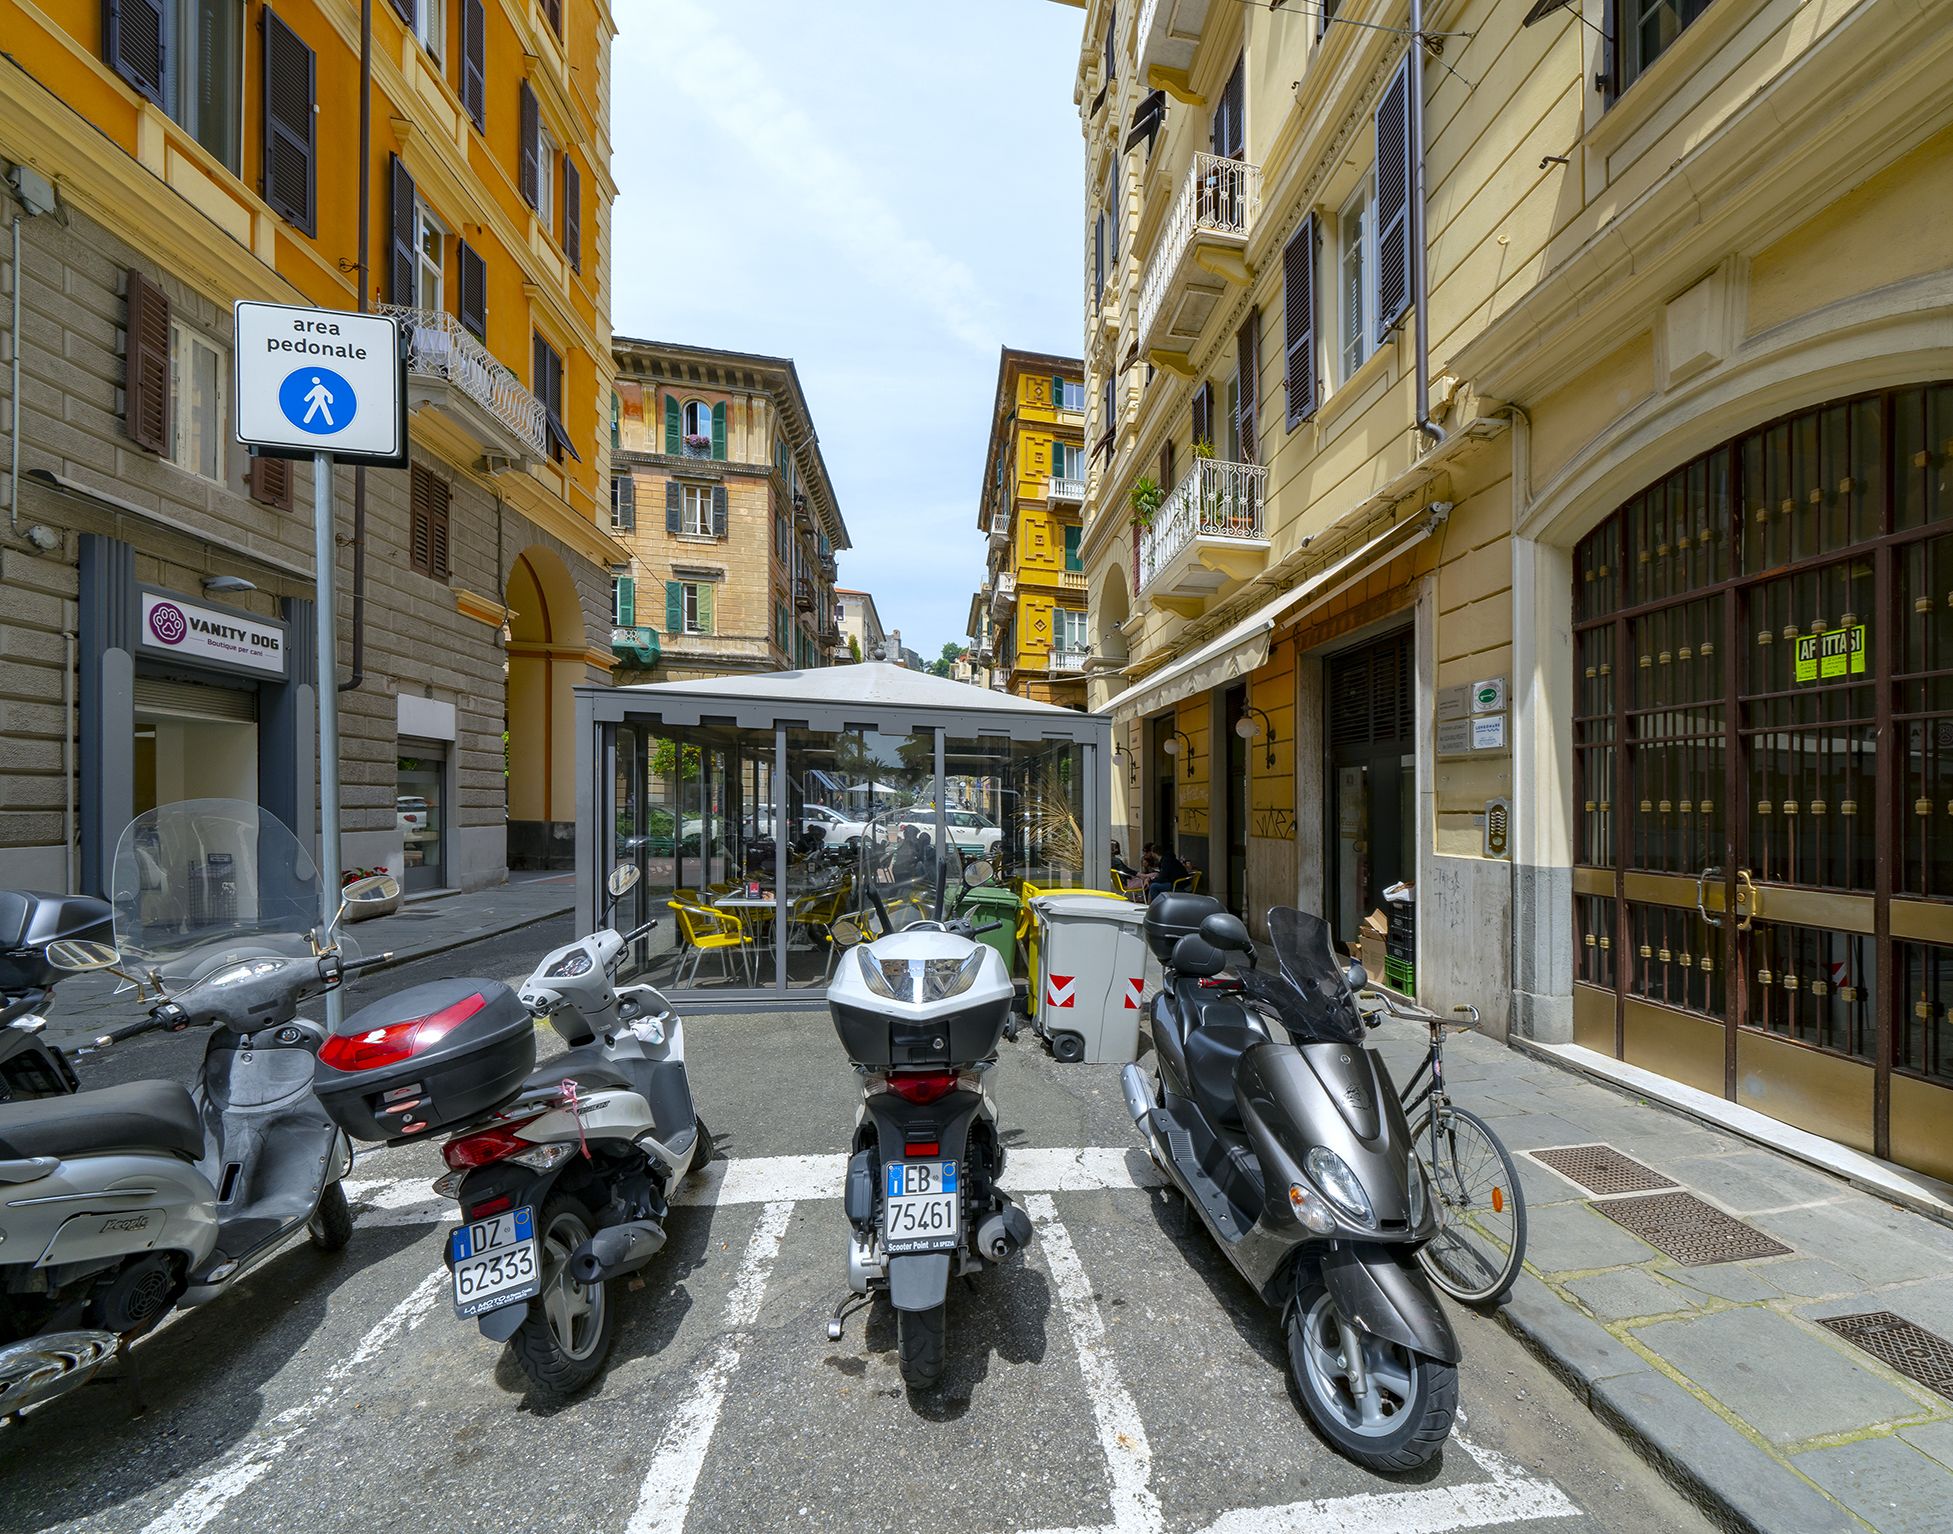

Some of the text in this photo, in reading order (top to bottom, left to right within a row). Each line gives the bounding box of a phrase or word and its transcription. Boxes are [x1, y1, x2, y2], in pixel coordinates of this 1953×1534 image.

[293, 319, 341, 336] area
[267, 338, 367, 360] pedonale
[189, 617, 279, 650] VANITY DOG
[207, 638, 263, 657] Boutique per cani
[1800, 630, 1860, 660] AFITTASI
[905, 1165, 931, 1194] EB
[890, 1200, 952, 1233] 75461
[472, 1218, 503, 1253] DZ
[888, 1243, 912, 1252] Scooter
[913, 1241, 929, 1250] Point
[459, 1246, 533, 1295] 62333
